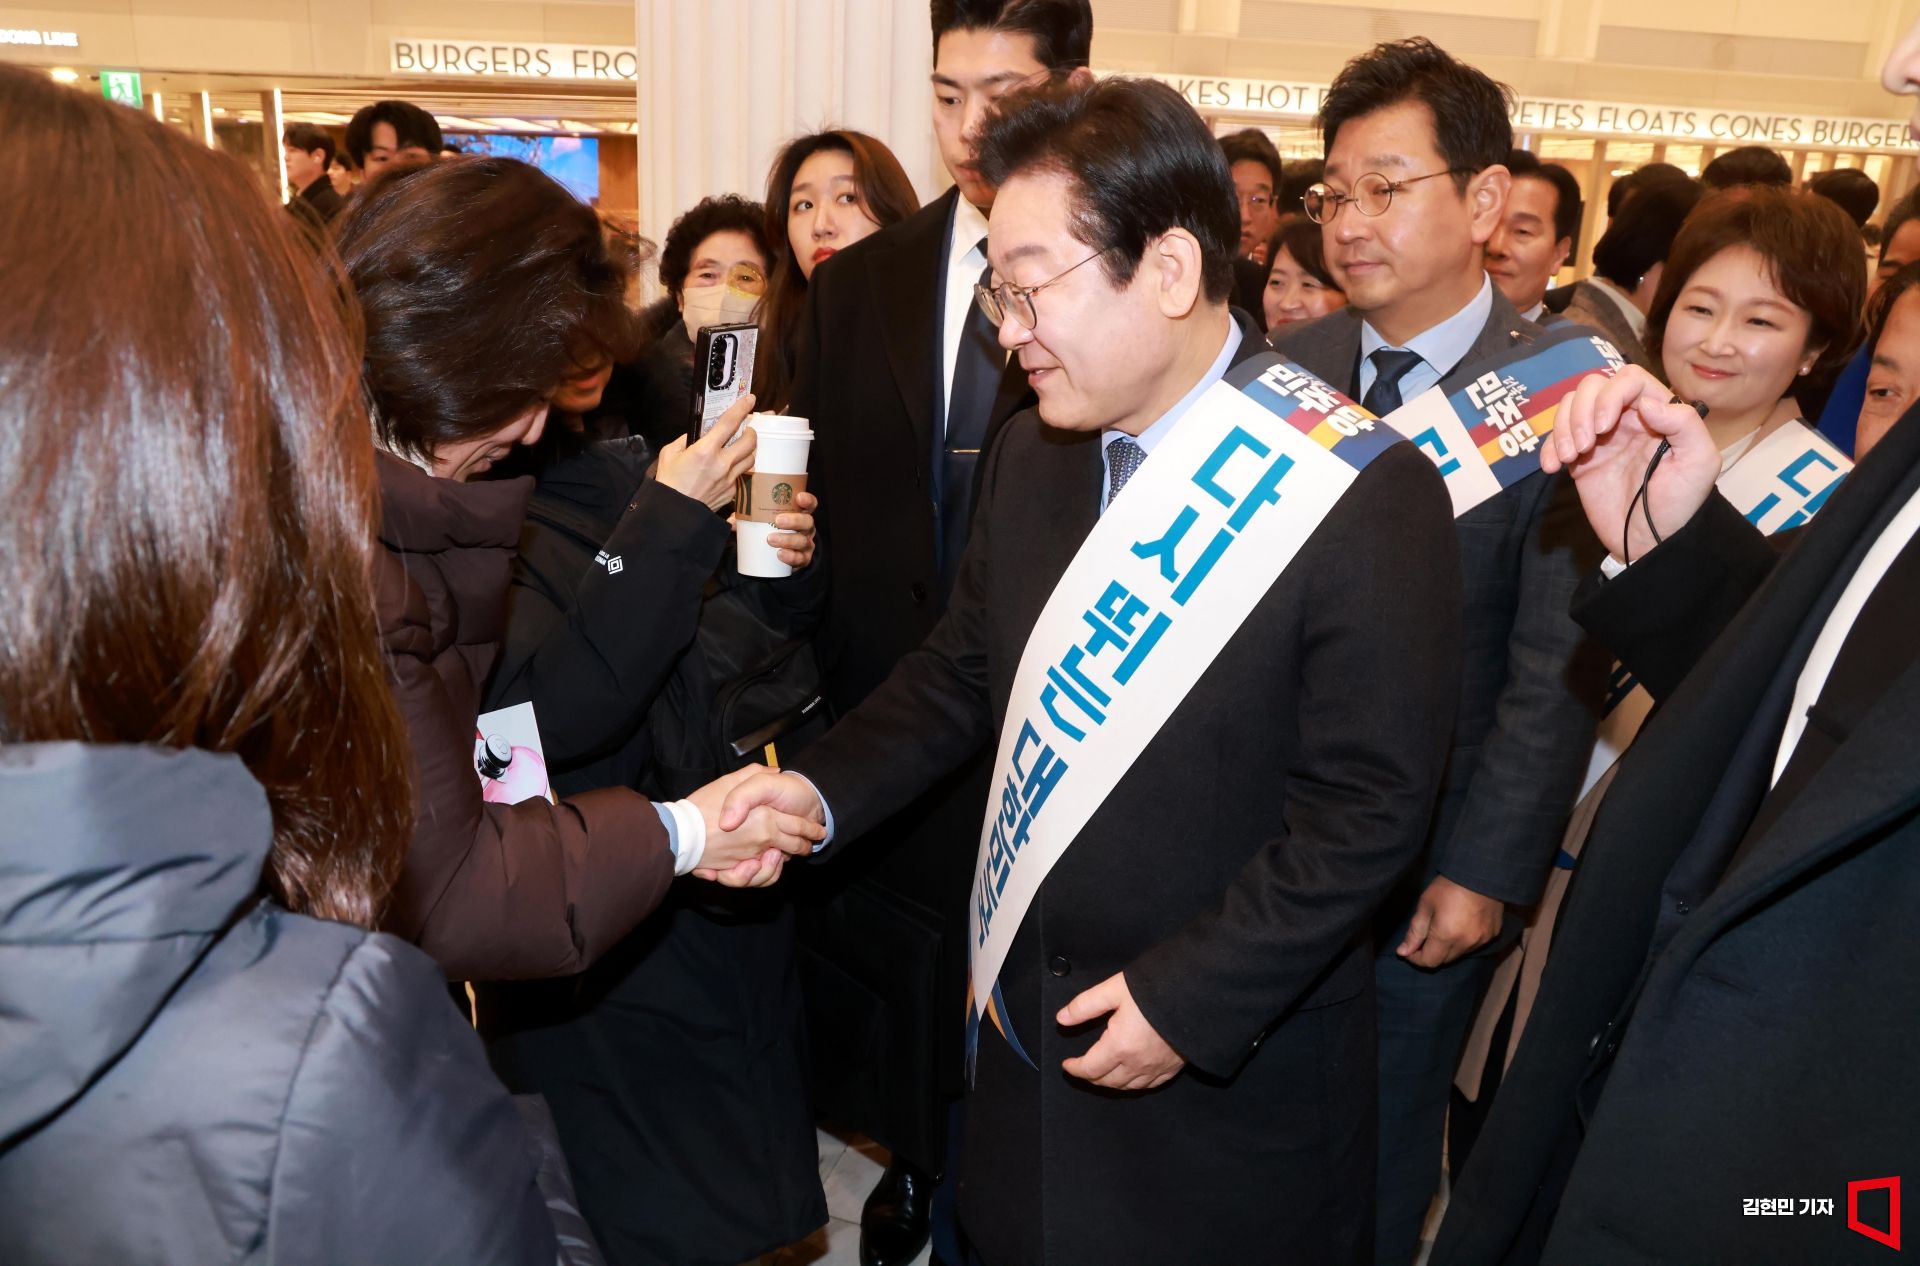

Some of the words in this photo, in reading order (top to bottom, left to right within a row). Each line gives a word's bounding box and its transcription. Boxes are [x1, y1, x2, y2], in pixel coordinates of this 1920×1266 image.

[394, 43, 552, 76] BURGERS
[572, 49, 637, 78] FRO
[1164, 79, 1231, 106] KES
[1246, 83, 1309, 111] HOT
[1597, 106, 1697, 135] FLOATS
[1709, 113, 1801, 142] CONES
[1812, 119, 1920, 147] BURGER
[1256, 363, 1376, 437] 민주당
[1464, 370, 1540, 458] 민주당
[1130, 424, 1296, 607] 다시
[1039, 579, 1173, 743] 뛰는
[977, 717, 1070, 950] 대한민국
